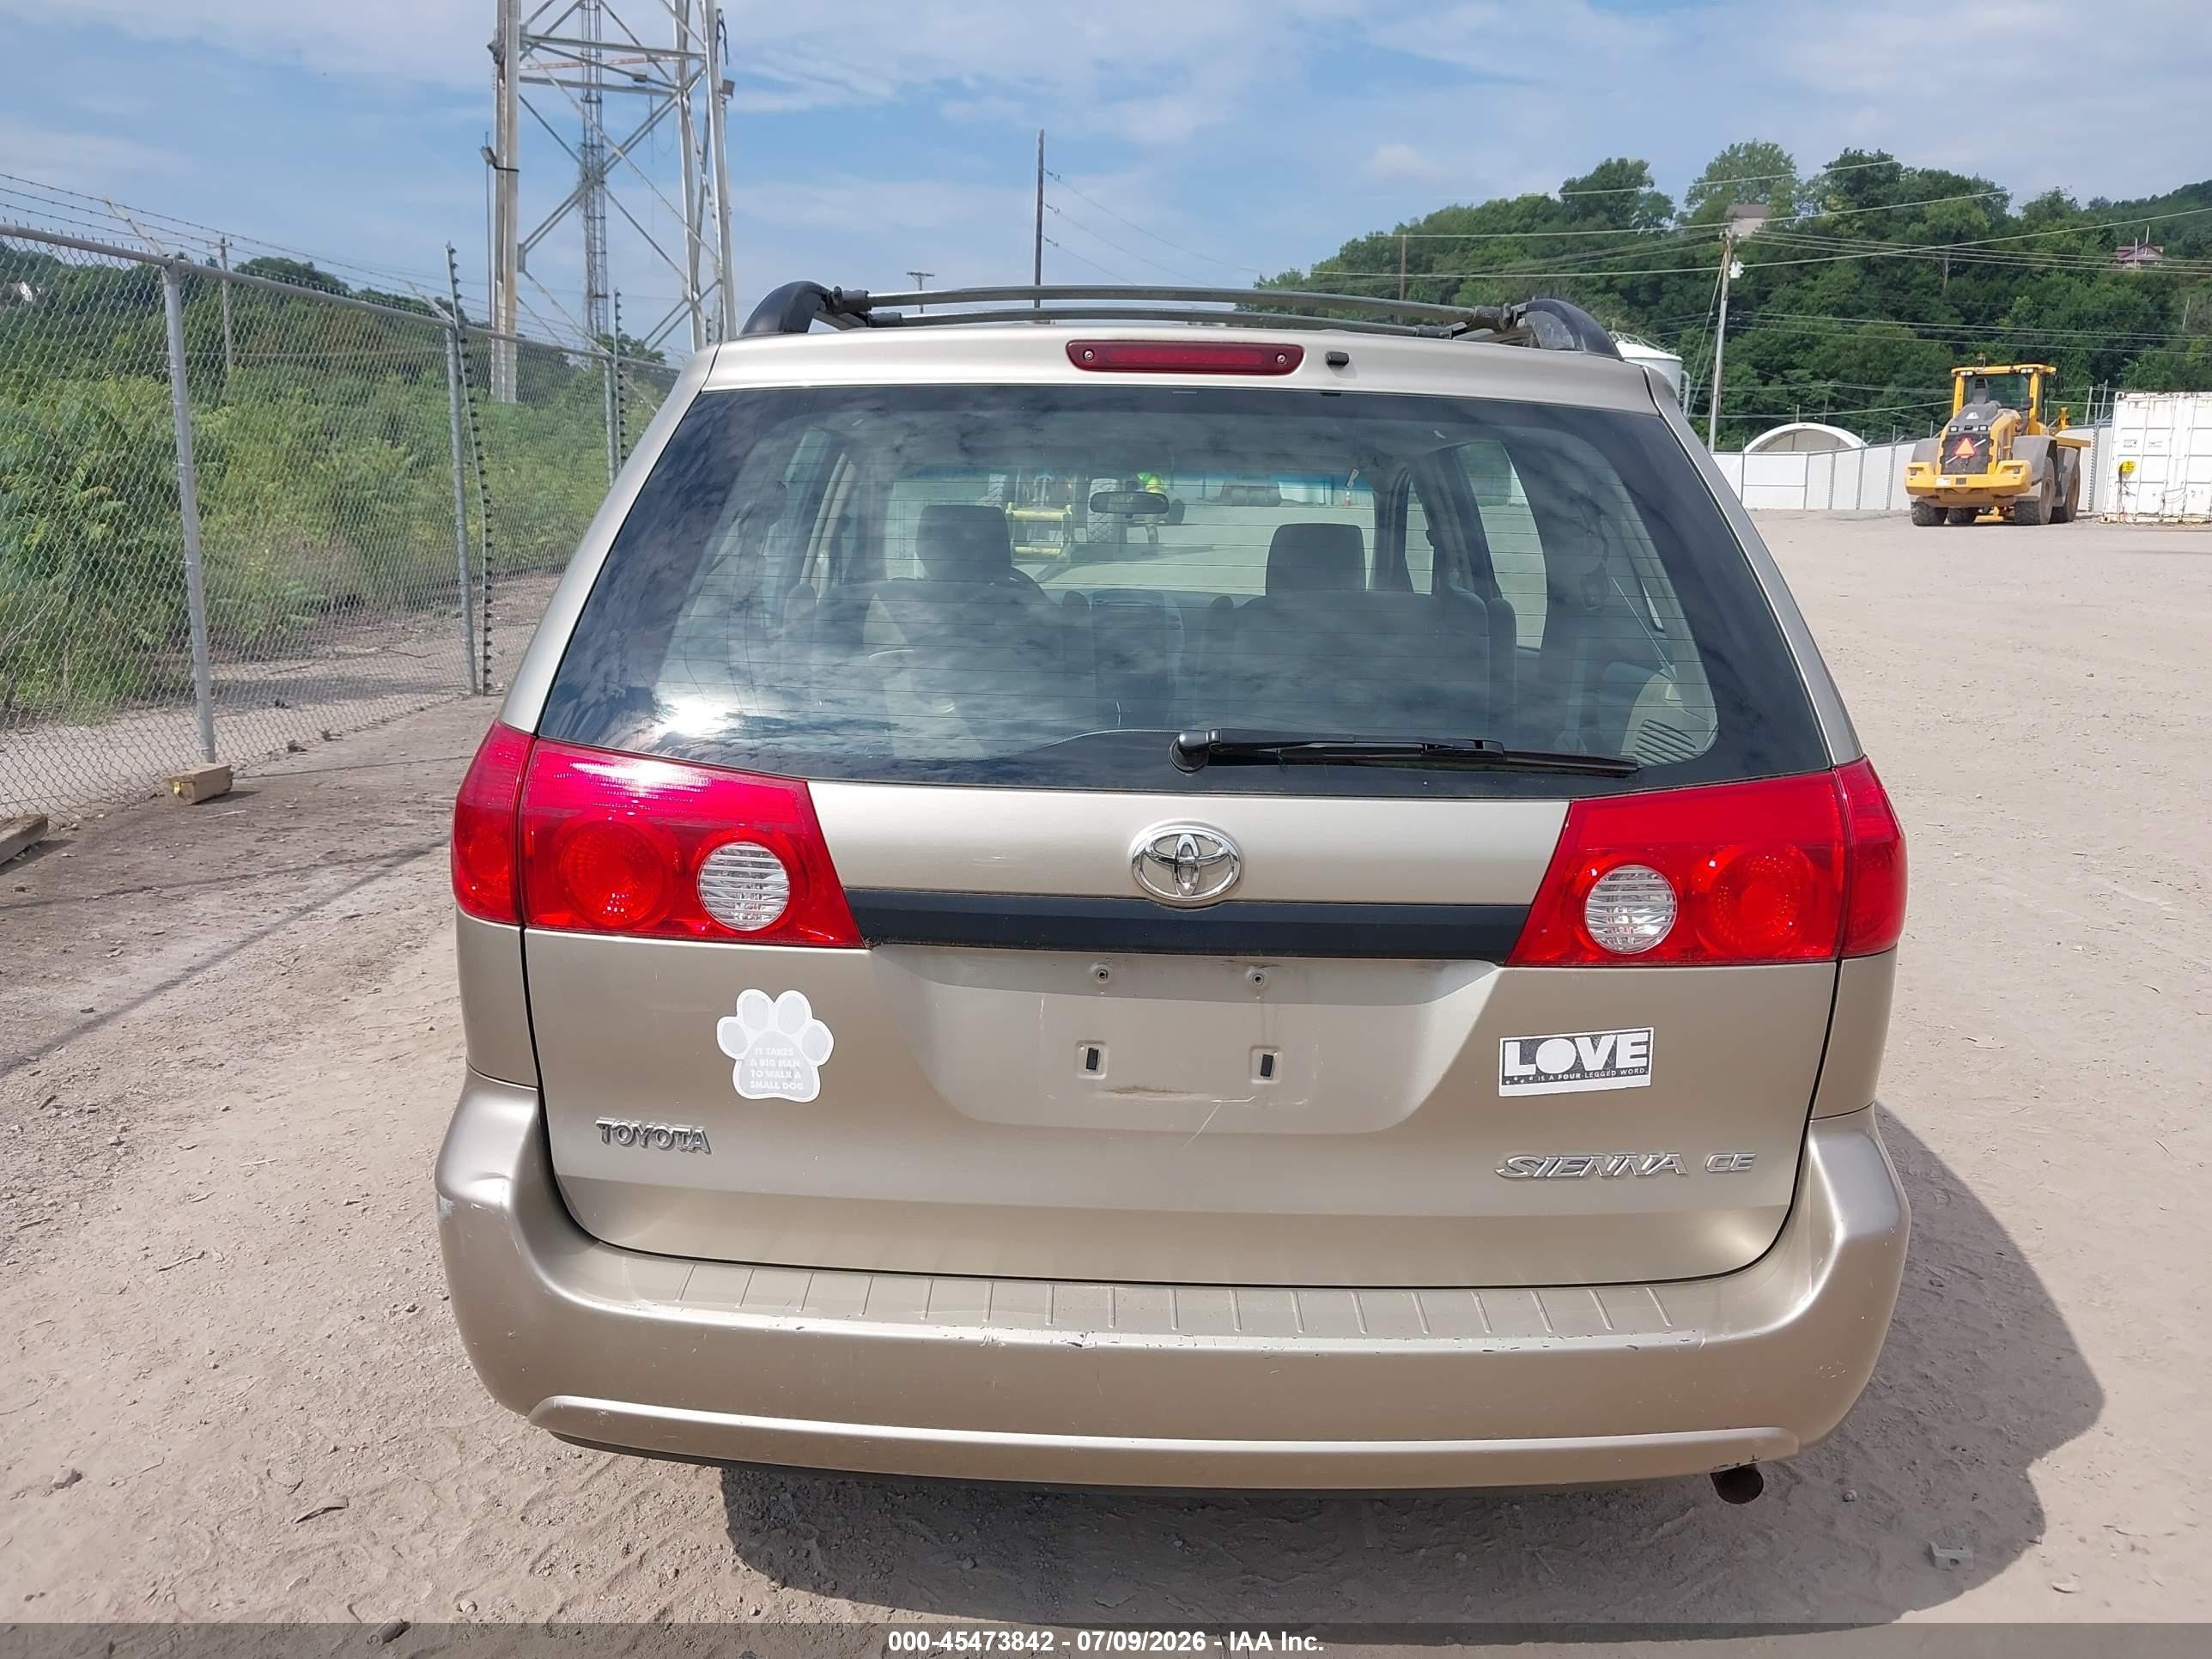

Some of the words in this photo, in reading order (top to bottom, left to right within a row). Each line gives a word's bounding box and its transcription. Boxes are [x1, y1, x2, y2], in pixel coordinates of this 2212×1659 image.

[765, 1048, 794, 1056] TAKES
[1504, 1032, 1649, 1076] LOVE
[750, 1058, 757, 1066] A
[759, 1058, 776, 1066] BIG
[778, 1058, 801, 1068] MAN
[750, 1069, 763, 1078] TO
[764, 1070, 793, 1079] WALK
[793, 1071, 802, 1079] A
[1558, 1070, 1617, 1080] FOUR-LEGGED
[750, 1080, 781, 1090] SMALL
[595, 1117, 712, 1156] TOYOTA
[1495, 1153, 1689, 1178] SIENNA
[1704, 1153, 1757, 1174] CE
